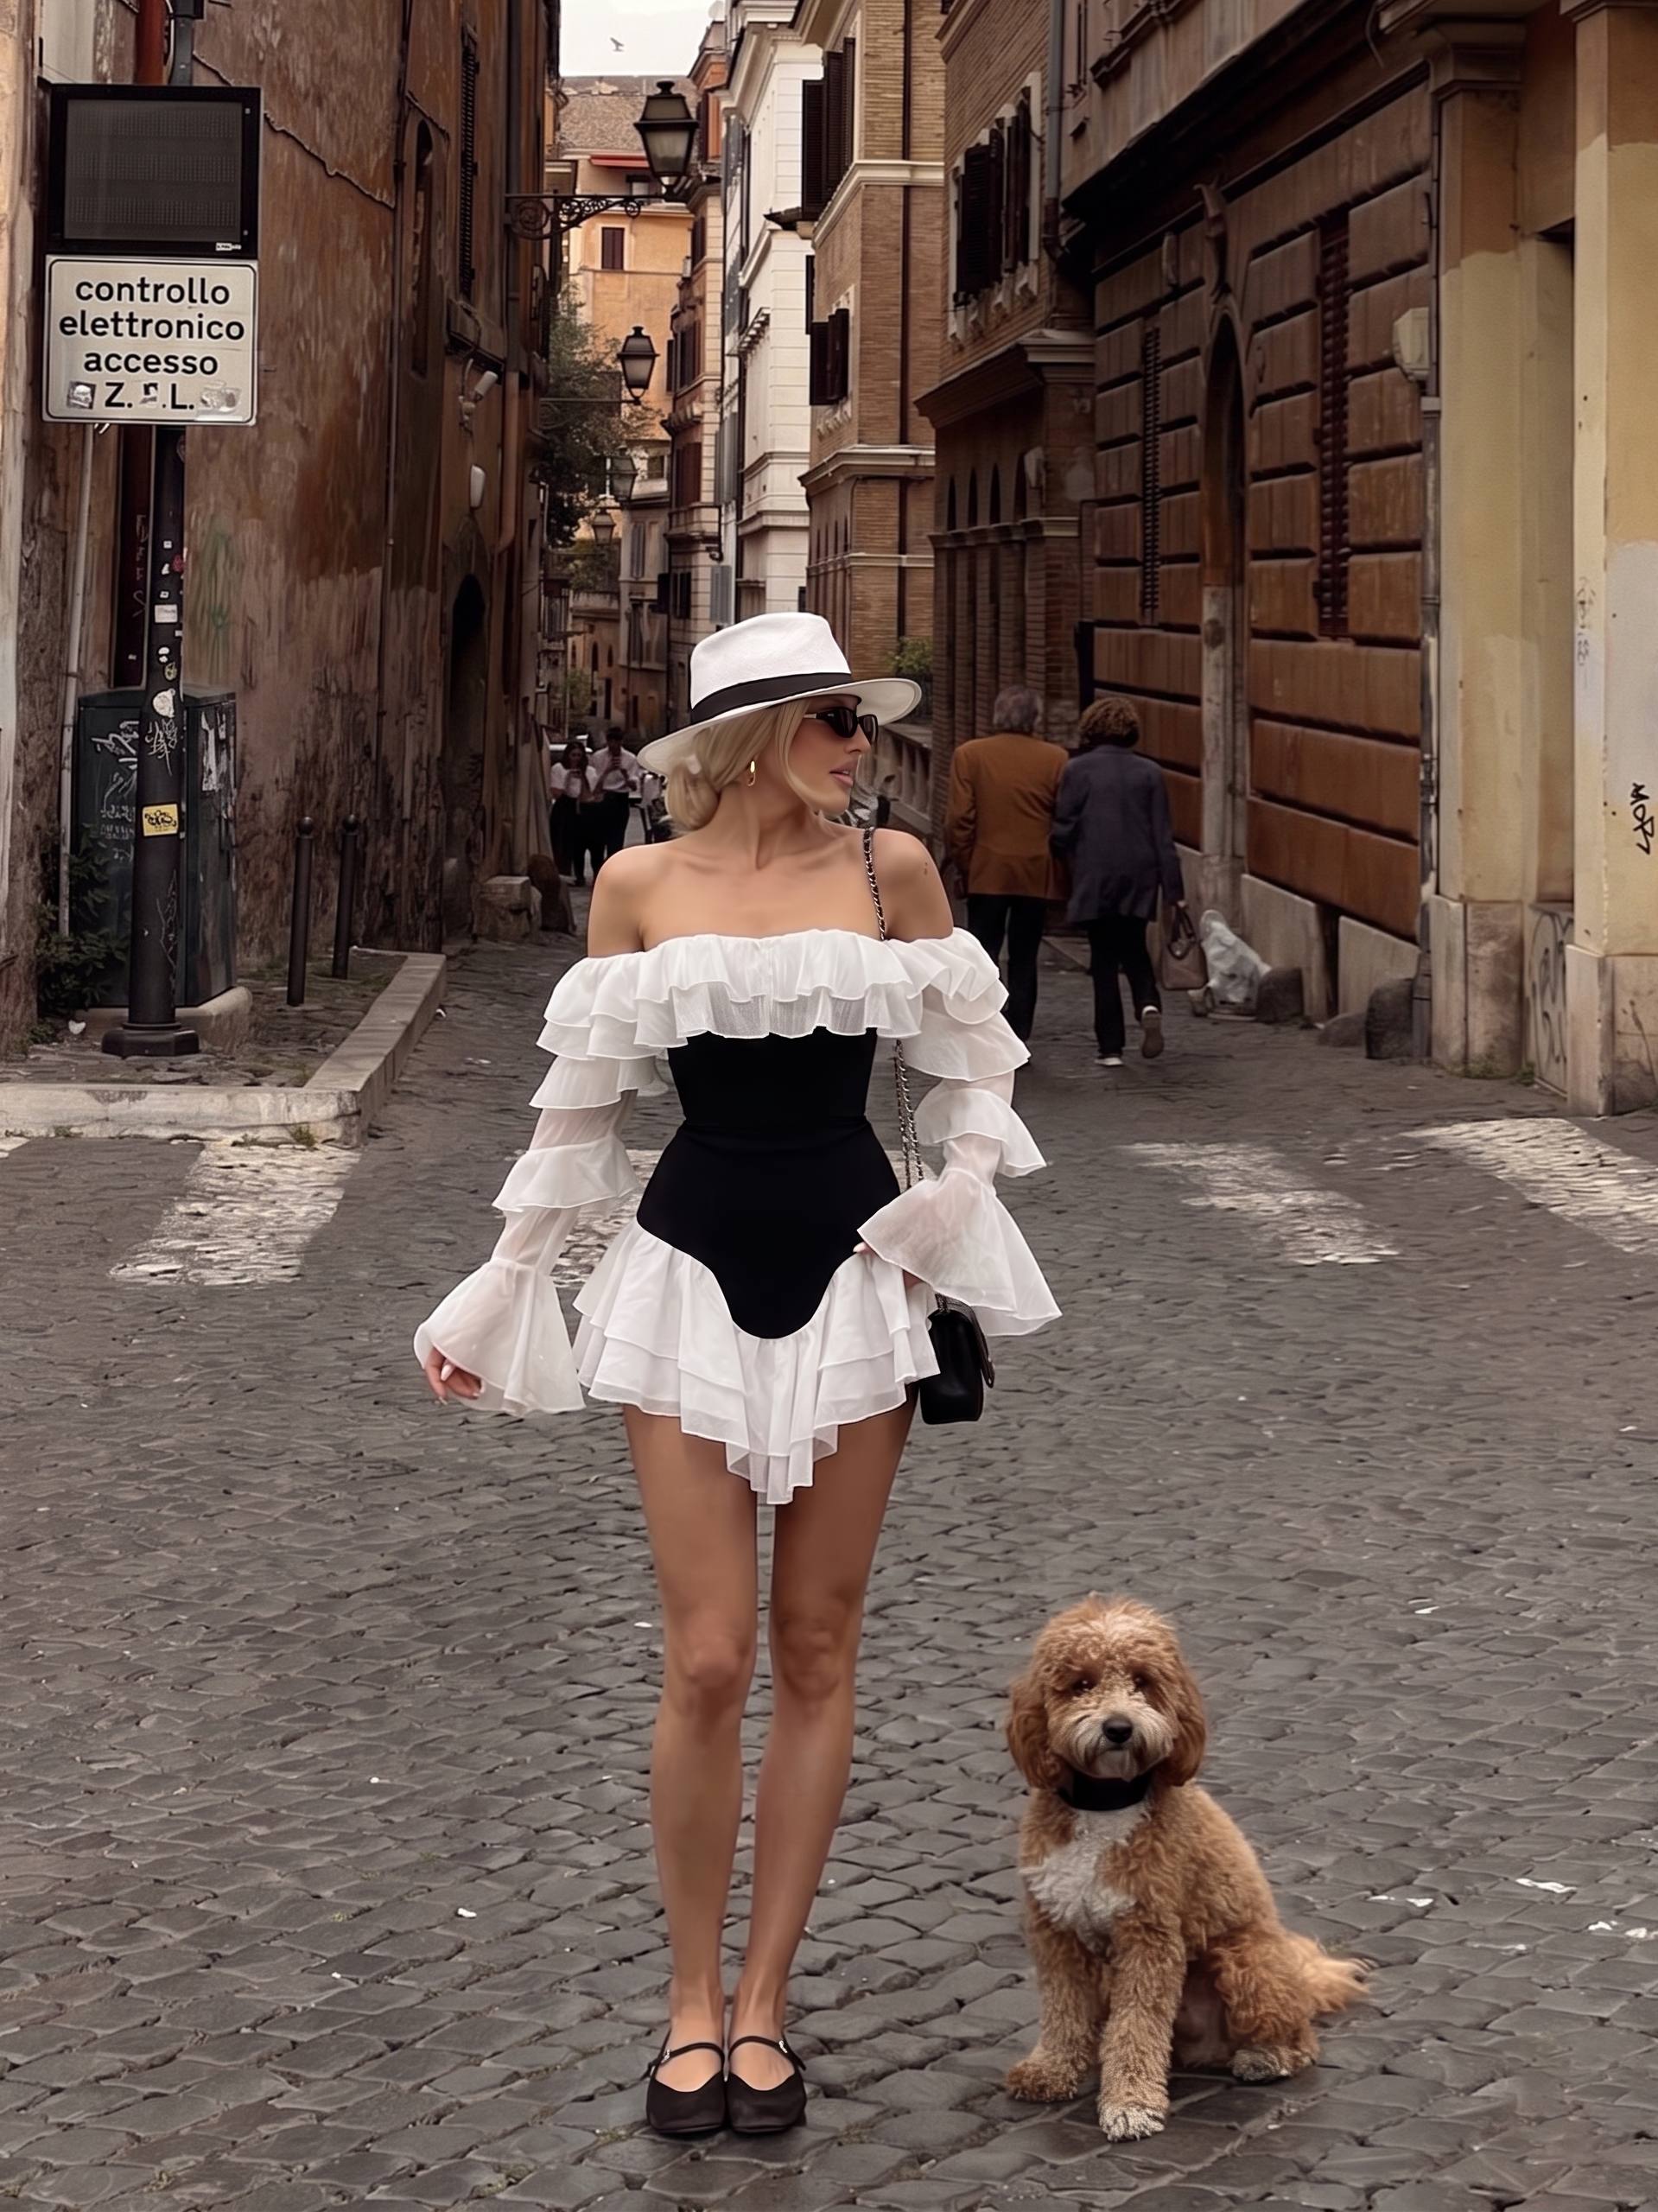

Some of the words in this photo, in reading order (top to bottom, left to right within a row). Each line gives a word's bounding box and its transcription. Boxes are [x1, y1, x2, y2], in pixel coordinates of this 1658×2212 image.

[75, 276, 230, 304] controllo
[59, 309, 245, 340] elettronico
[84, 352, 219, 375] accesso
